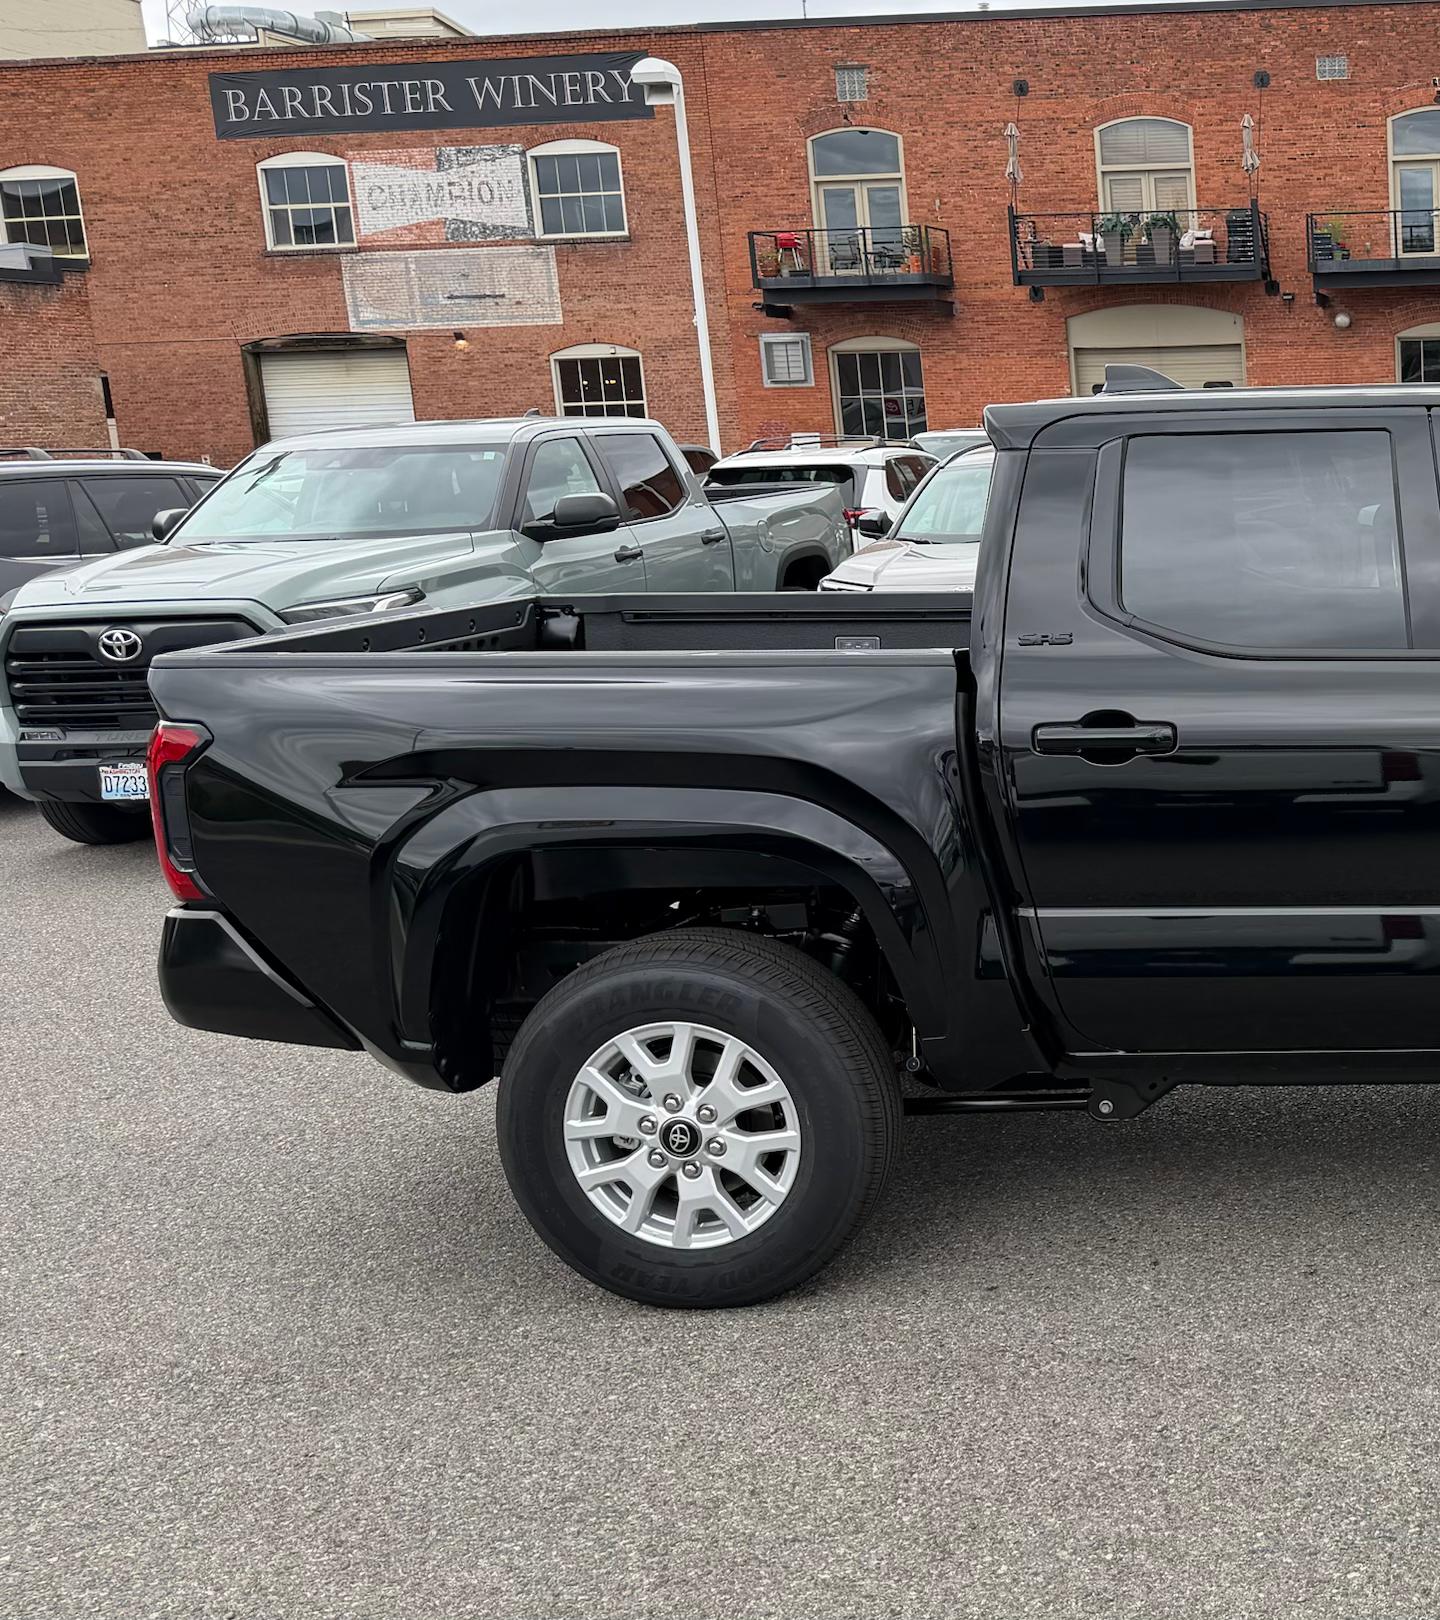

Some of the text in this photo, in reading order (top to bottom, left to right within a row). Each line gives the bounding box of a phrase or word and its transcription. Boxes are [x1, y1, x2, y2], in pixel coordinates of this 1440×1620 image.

[221, 69, 637, 123] BARRISTER WINERY
[1017, 632, 1073, 646] SR5
